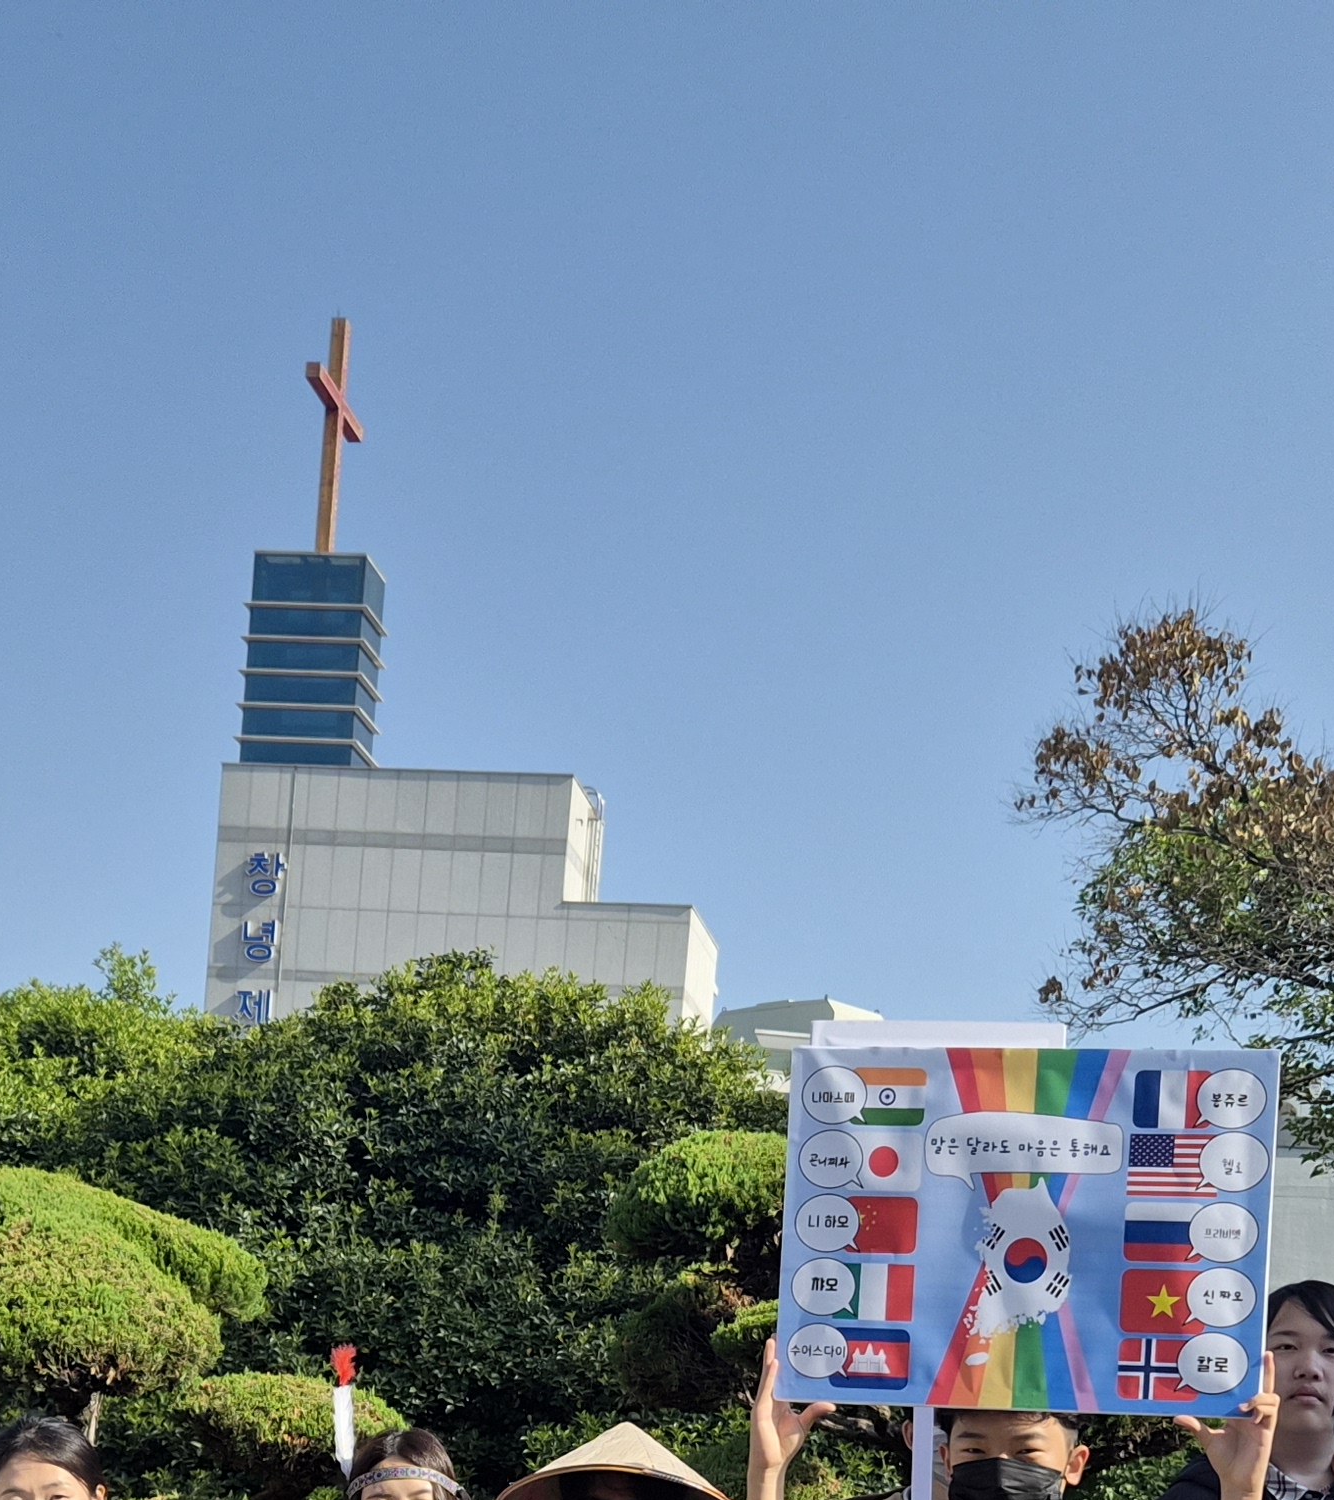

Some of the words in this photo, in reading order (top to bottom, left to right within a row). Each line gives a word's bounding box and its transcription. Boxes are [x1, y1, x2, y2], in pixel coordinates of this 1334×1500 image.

[1210, 1092, 1249, 1108] 봉쥬르
[930, 1135, 959, 1155] 말은
[966, 1136, 1011, 1156] 달라도
[1018, 1139, 1061, 1158] 마음은
[1068, 1138, 1112, 1158] 통해요
[807, 1215, 820, 1228] 니
[824, 1214, 849, 1228] 하오
[1203, 1289, 1215, 1305] 신
[1219, 1290, 1244, 1302] 짜오
[790, 1344, 846, 1359] 수어스다이
